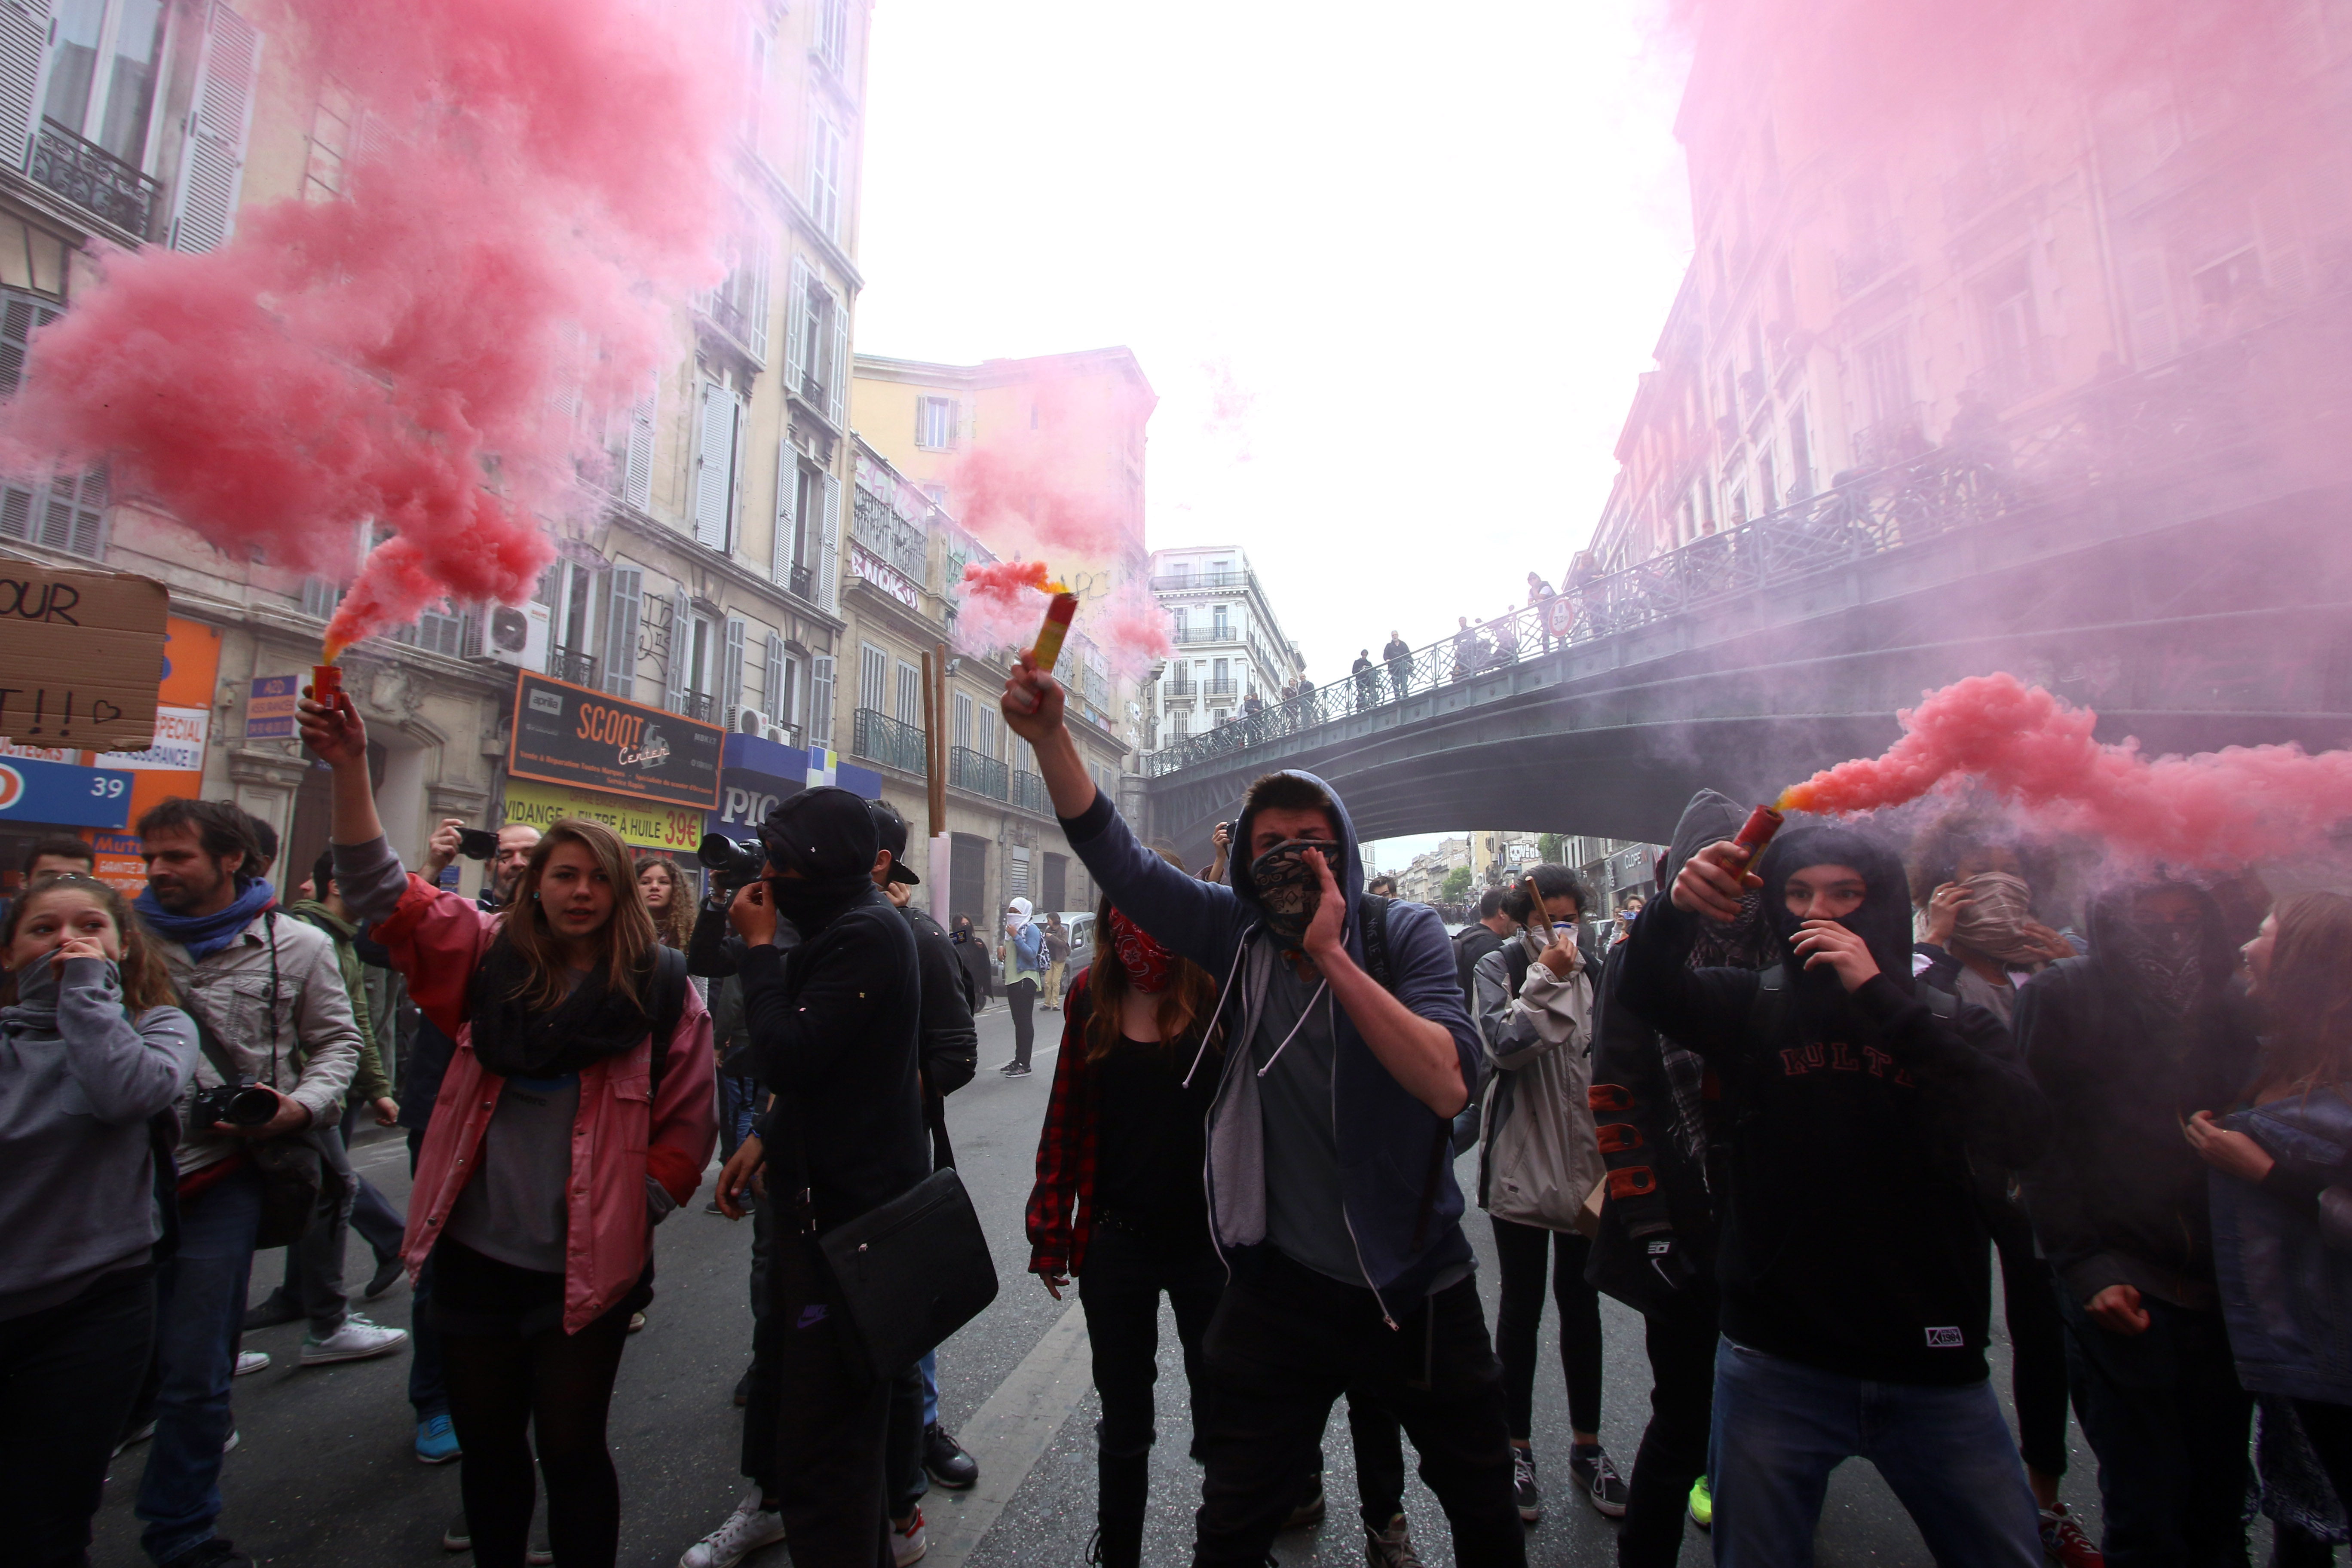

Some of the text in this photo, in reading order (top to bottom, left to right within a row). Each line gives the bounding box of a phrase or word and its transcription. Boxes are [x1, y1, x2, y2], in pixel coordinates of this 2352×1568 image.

[532, 695, 558, 709] aprilia
[618, 746, 671, 765] Center
[90, 777, 124, 799] 39
[570, 790, 652, 814] OFFRE EXCEPTIONNELLE
[504, 800, 563, 825] VIDANGE
[620, 813, 627, 835] À
[631, 818, 661, 839] HUILE
[665, 810, 698, 847] 39€
[802, 1304, 828, 1318] NIKE
[1942, 1333, 1961, 1343] 1984
